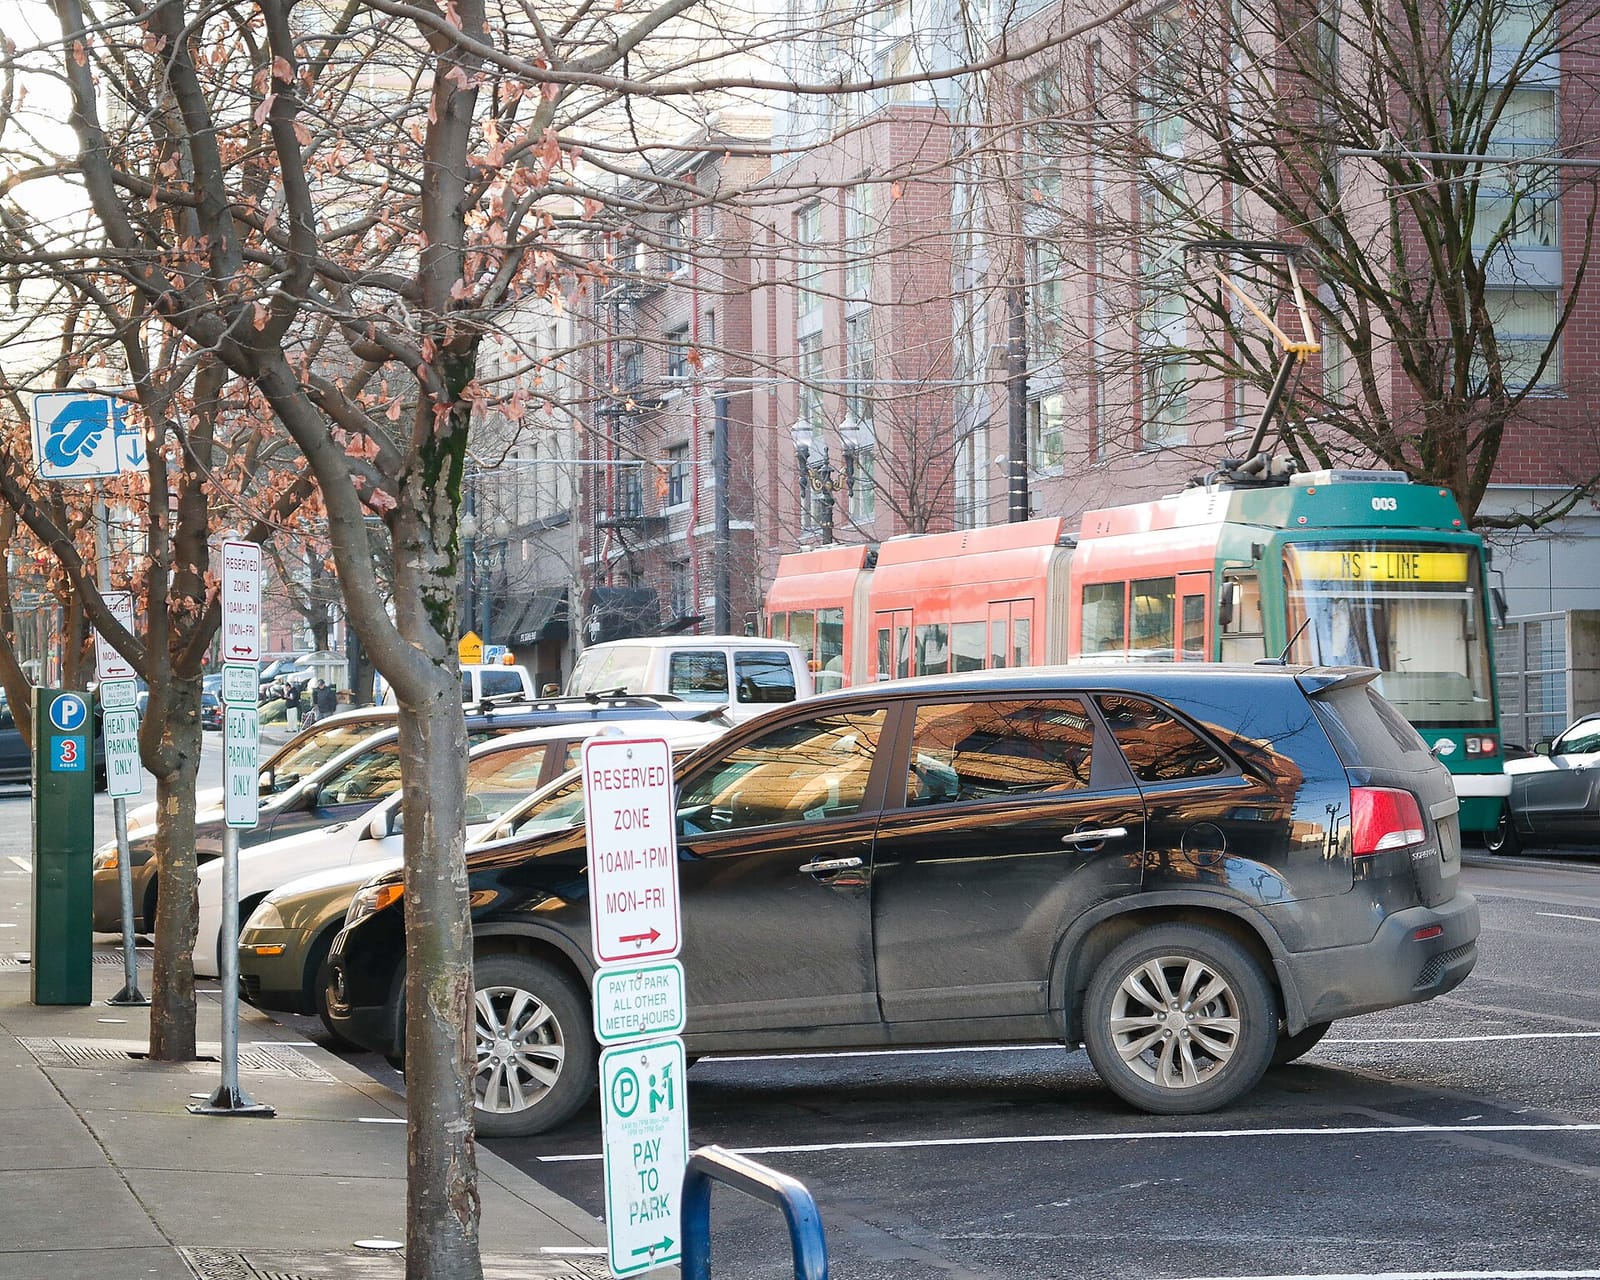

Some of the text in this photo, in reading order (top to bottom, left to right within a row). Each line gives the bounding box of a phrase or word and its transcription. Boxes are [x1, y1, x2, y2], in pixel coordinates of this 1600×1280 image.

[1371, 497, 1397, 511] 003
[226, 557, 258, 572] RESERVED
[1341, 553, 1361, 579] NS
[1387, 553, 1420, 579] LINE
[233, 580, 250, 593] ZONE
[226, 601, 257, 616] 10AM-1PM
[228, 623, 256, 637] MON-FRI
[61, 700, 78, 725] P
[107, 717, 136, 735] HEAD IN
[228, 717, 256, 740] HEAD IN
[60, 739, 77, 763] 3
[108, 737, 137, 756] PARKING
[228, 746, 256, 768] PARKING
[114, 759, 132, 776] ONLY
[593, 766, 665, 791] RESERVED
[233, 774, 251, 796] ONLY
[614, 807, 650, 830] ZONE
[599, 846, 668, 873] 10AM-1PM
[606, 887, 665, 914] MON-FRI
[609, 975, 669, 994] PAY TO PARK
[613, 992, 667, 1011] ALL OTHER
[605, 1008, 676, 1030] METER HOURS
[620, 1077, 634, 1108] P
[633, 1137, 661, 1166] PAY
[638, 1167, 659, 1194] TO
[629, 1193, 671, 1226] PARK
